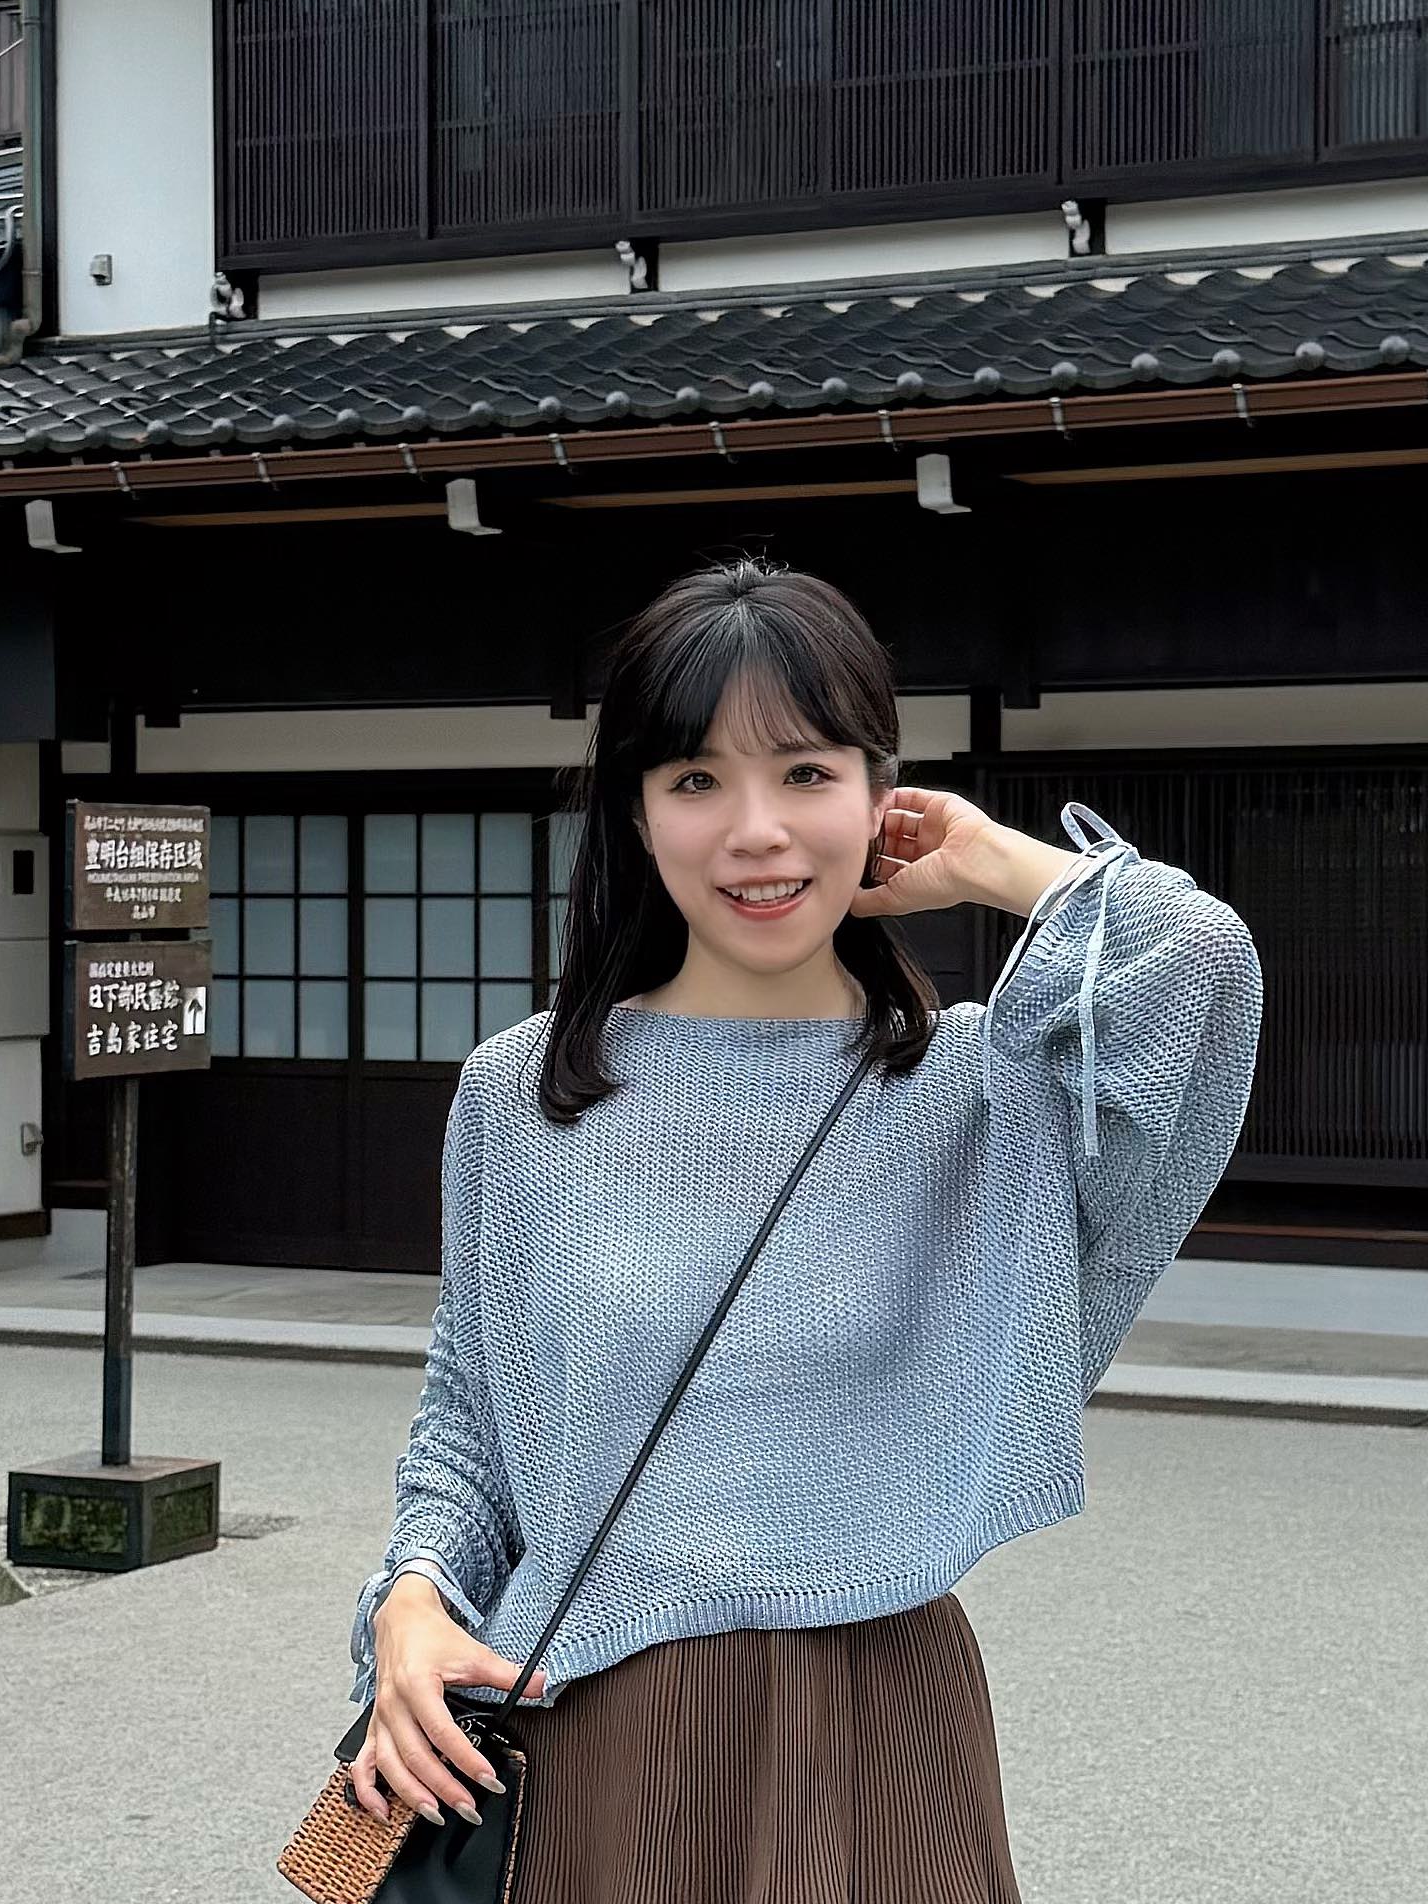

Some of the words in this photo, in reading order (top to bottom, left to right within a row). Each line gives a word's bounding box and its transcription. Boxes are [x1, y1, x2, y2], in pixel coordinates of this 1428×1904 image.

[87, 1020, 178, 1056] 吉島家住宅
